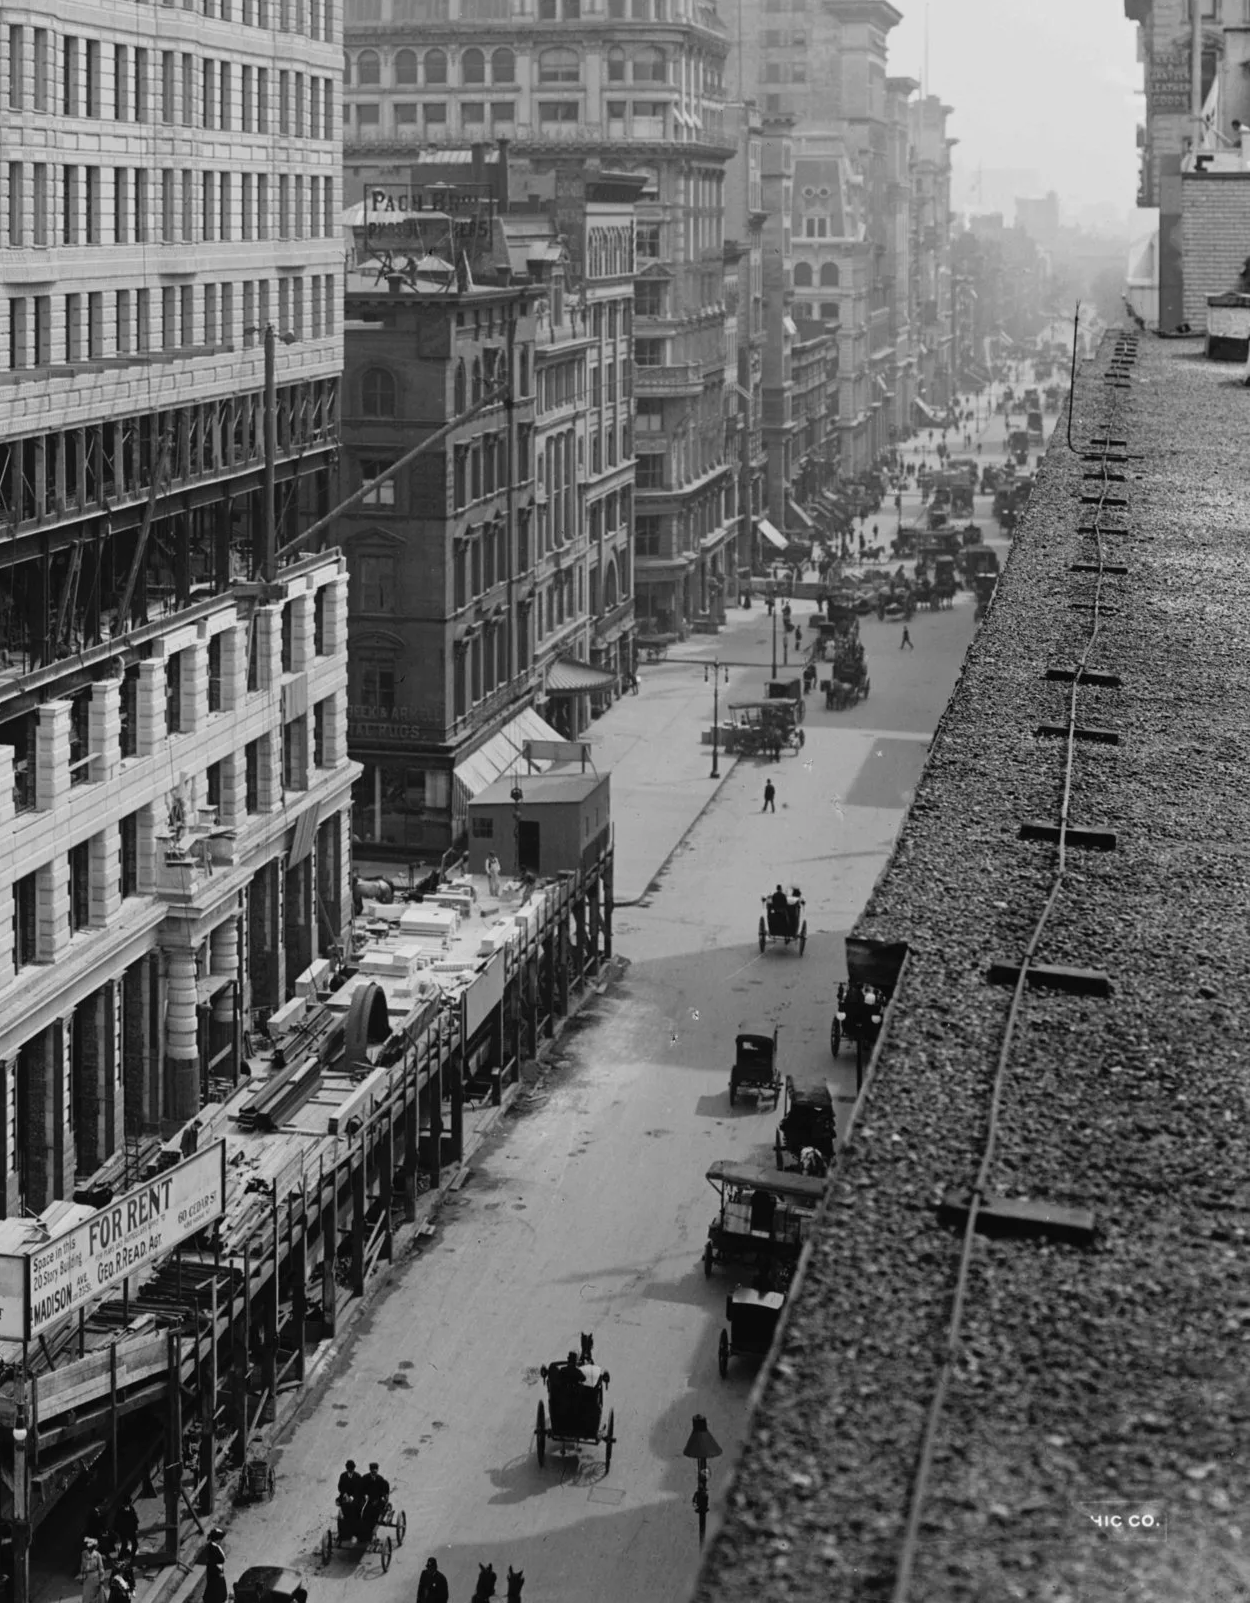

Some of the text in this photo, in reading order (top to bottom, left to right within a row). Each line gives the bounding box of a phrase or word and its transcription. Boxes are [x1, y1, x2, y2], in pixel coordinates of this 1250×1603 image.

[89, 1177, 173, 1257] FOR RENT
[178, 1209, 188, 1224] 60
[188, 1195, 209, 1218] CEDAR
[33, 1238, 76, 1274] Space in this
[34, 1274, 43, 1292] 20
[43, 1268, 58, 1286] Story
[34, 1282, 72, 1327] MADISON
